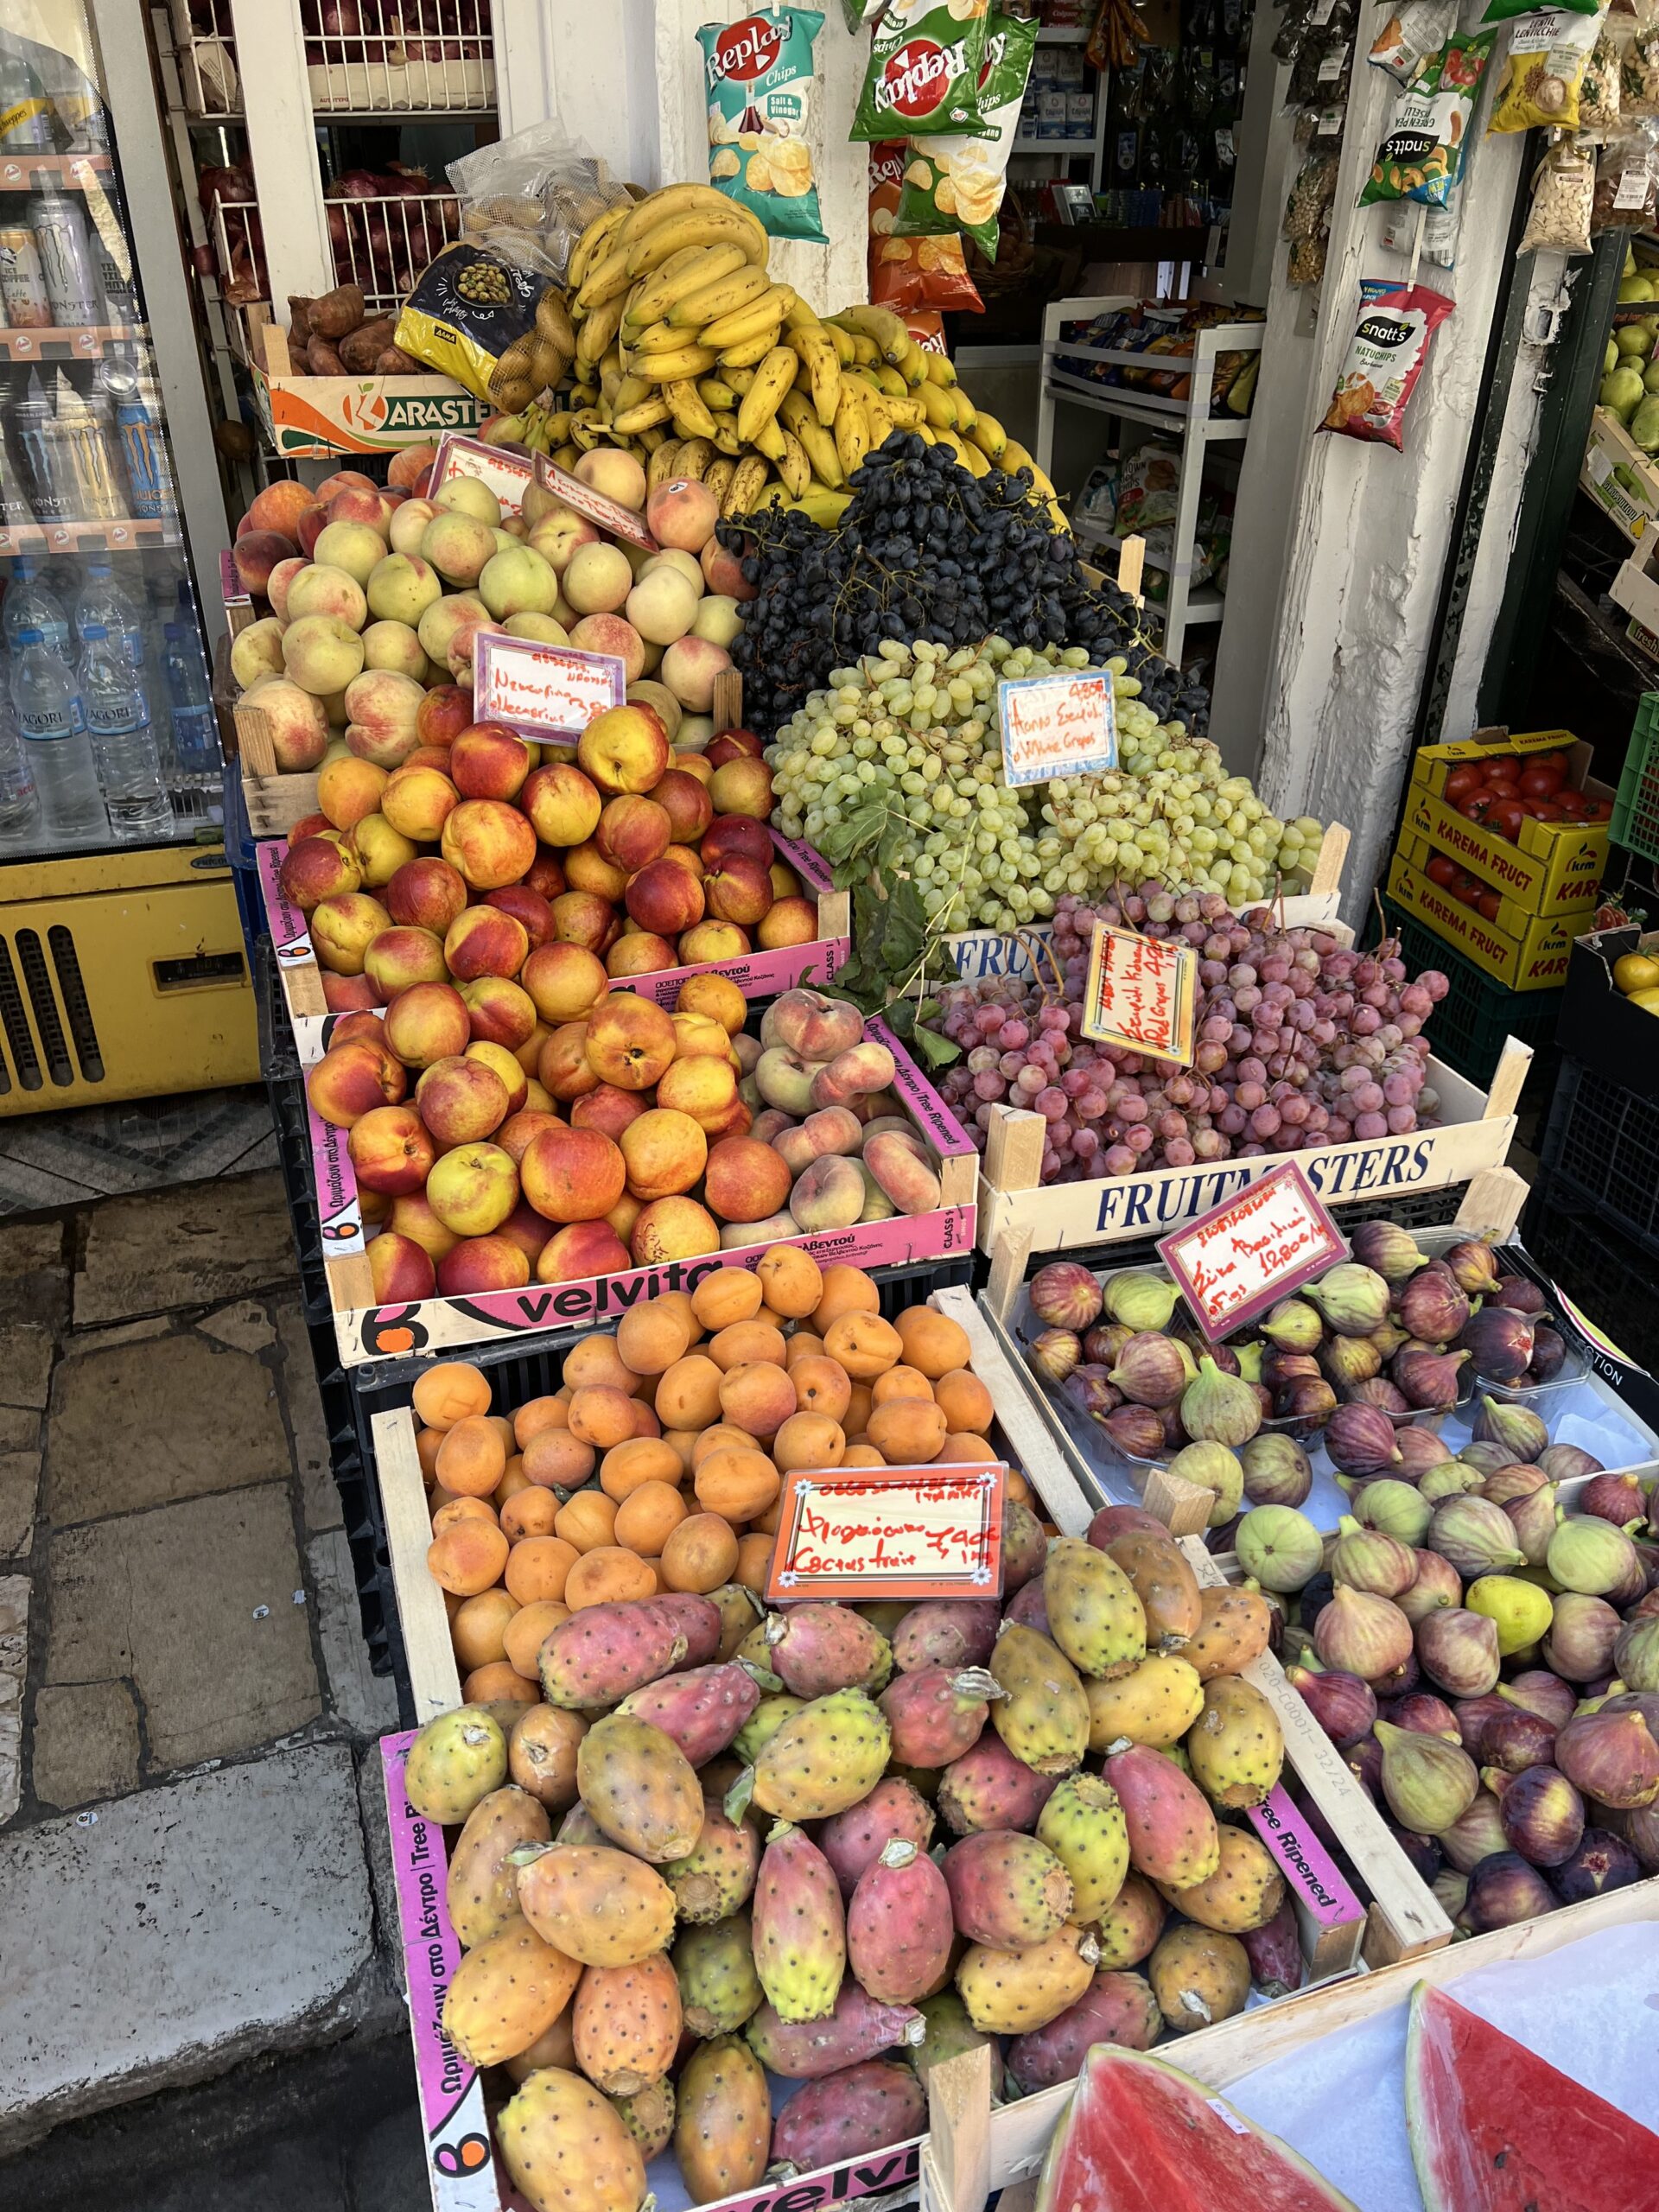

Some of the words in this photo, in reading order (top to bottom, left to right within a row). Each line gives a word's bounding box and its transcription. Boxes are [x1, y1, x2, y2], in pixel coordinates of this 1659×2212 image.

[1515, 27, 1561, 39] LENTICCHIE
[1529, 16, 1556, 29] LENTIL
[707, 16, 793, 91] Replay
[873, 35, 904, 54] Chips
[766, 66, 797, 86] Chips
[874, 40, 969, 113] Replay
[771, 96, 786, 105] Salt
[771, 105, 800, 118] Vinegar
[1395, 118, 1408, 128] PEA
[1409, 118, 1435, 128] GREEN
[53, 299, 99, 311] ONSTER
[1354, 345, 1397, 363] NATUCHIPS
[266, 847, 281, 868] Ripened
[1437, 819, 1488, 865] KAREMA
[1491, 855, 1533, 892] FRUCT
[807, 859, 830, 884] Ripened
[1419, 890, 1467, 936] KAREMA
[1470, 928, 1509, 965] FRUCT
[827, 950, 836, 983] CLASS
[1149, 982, 1172, 1018] Grapes
[897, 1065, 922, 1095] Δέντρο
[323, 1122, 337, 1147] Δέντρο
[917, 1092, 935, 1113] Tree
[927, 1109, 960, 1148] Ripened
[327, 1163, 346, 1209] Ωριμάζουν
[943, 1215, 954, 1249] CLASS
[517, 1259, 724, 1323] velvita
[1211, 1283, 1247, 1313] Figs
[792, 1546, 865, 1574] Cactus
[410, 1821, 429, 1862] Tree
[1262, 1796, 1282, 1834] ree
[1274, 1831, 1337, 1909] Ripened
[417, 1871, 442, 1939] Δέντρο
[429, 1942, 448, 1978] στο
